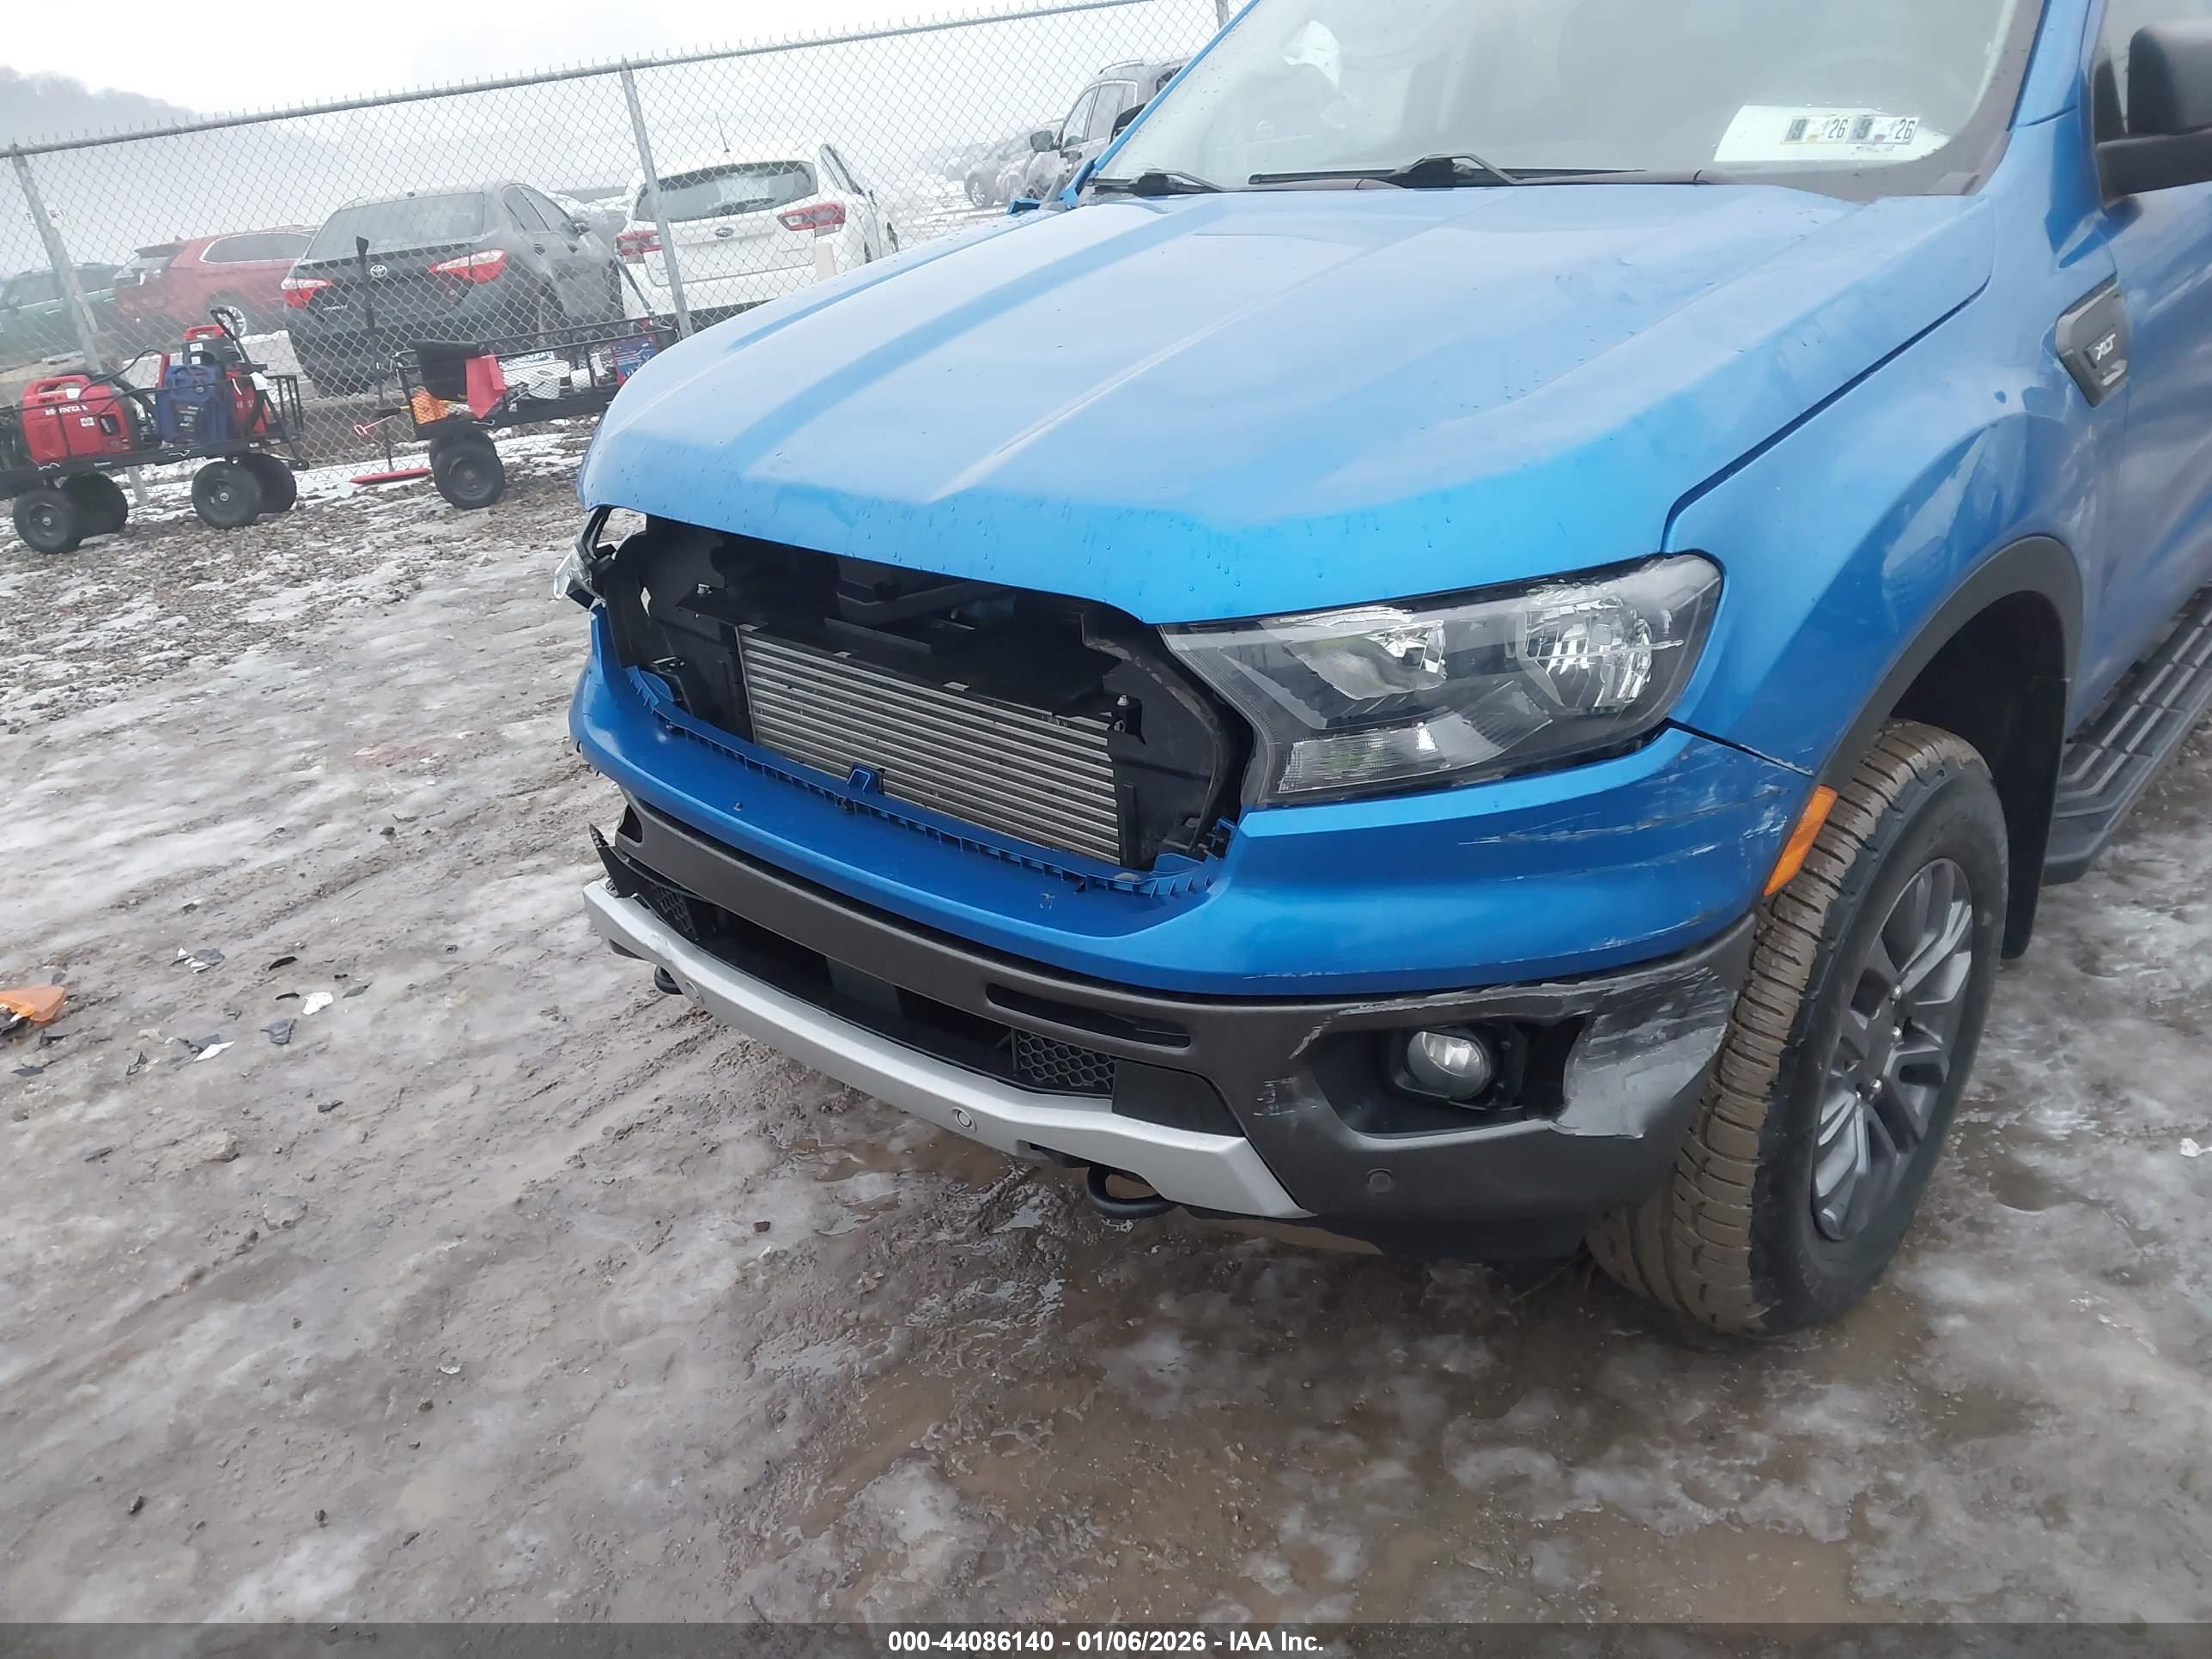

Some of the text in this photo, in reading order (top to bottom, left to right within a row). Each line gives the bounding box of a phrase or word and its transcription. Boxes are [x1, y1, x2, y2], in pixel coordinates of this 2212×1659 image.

[1827, 118, 1849, 139] 26
[1894, 118, 1915, 140] 26
[2094, 332, 2117, 362] XLT
